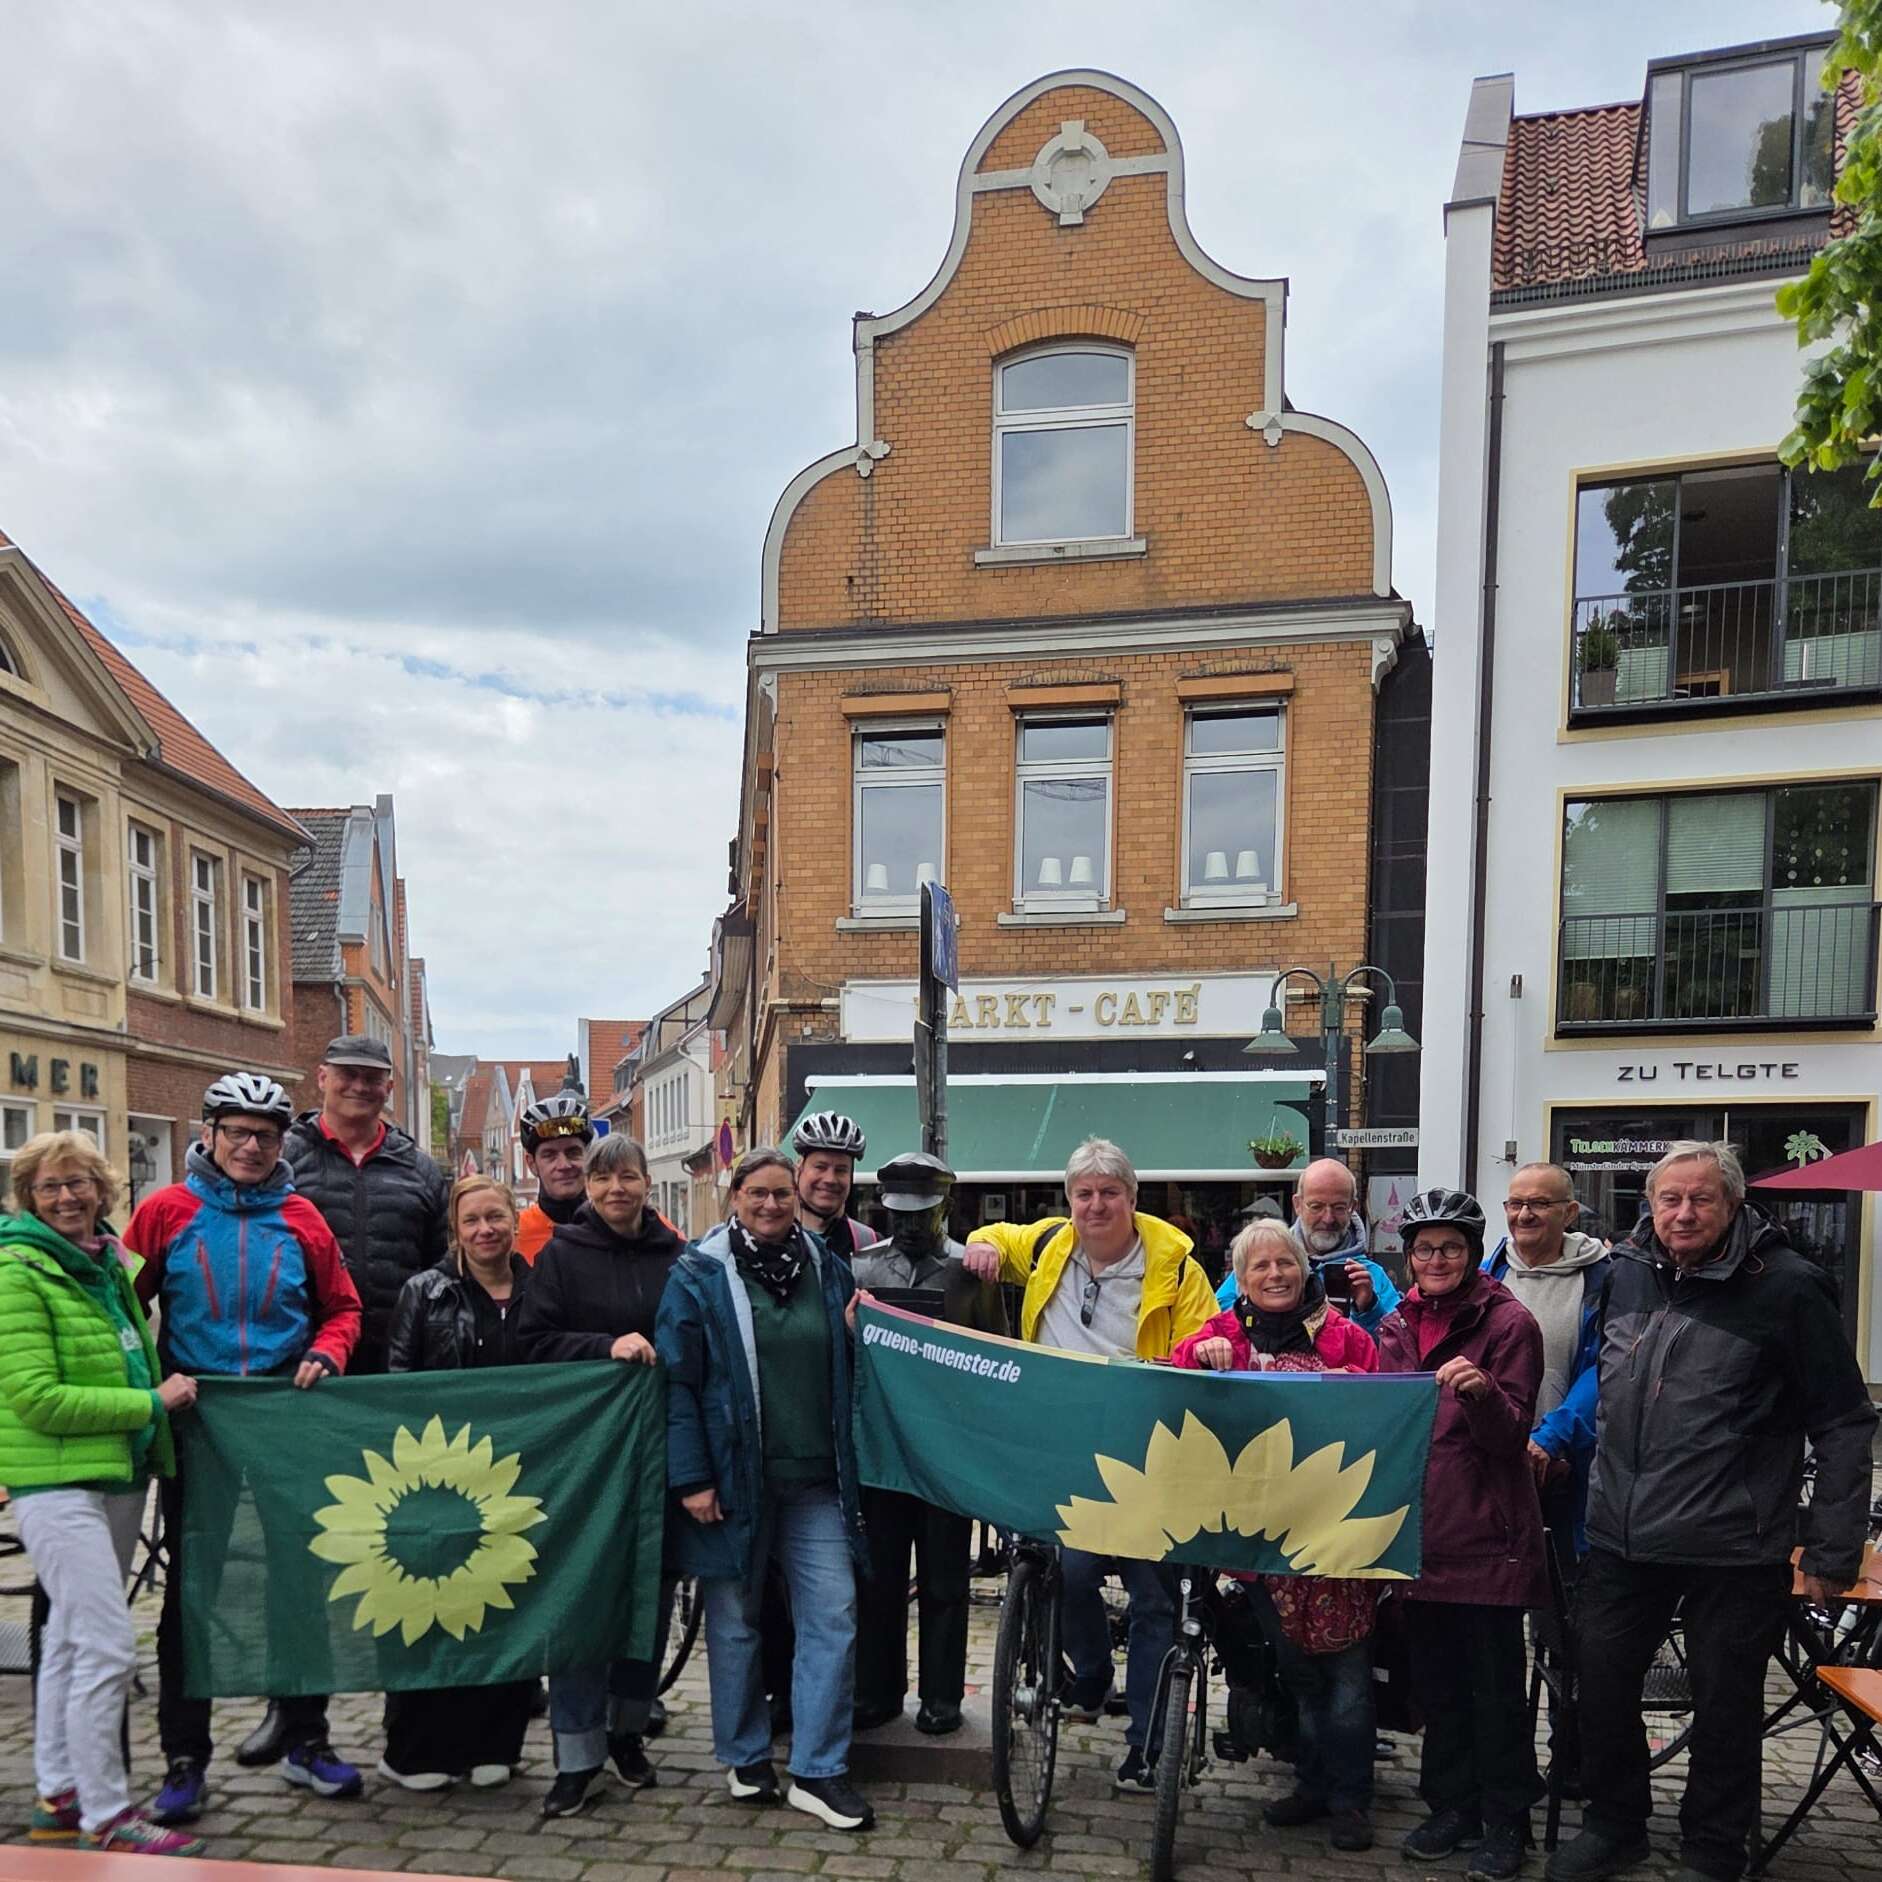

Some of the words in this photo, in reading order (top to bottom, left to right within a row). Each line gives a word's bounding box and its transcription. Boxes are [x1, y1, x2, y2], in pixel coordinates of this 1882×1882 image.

[913, 993, 1056, 1029] ARKT
[1094, 983, 1202, 1026] CAFÉ
[1617, 1066, 1658, 1081] ZU
[1673, 1062, 1800, 1080] TELGTE
[1341, 1131, 1415, 1146] Kapellenstraße
[862, 1323, 1022, 1384] gruene-muenster.de
